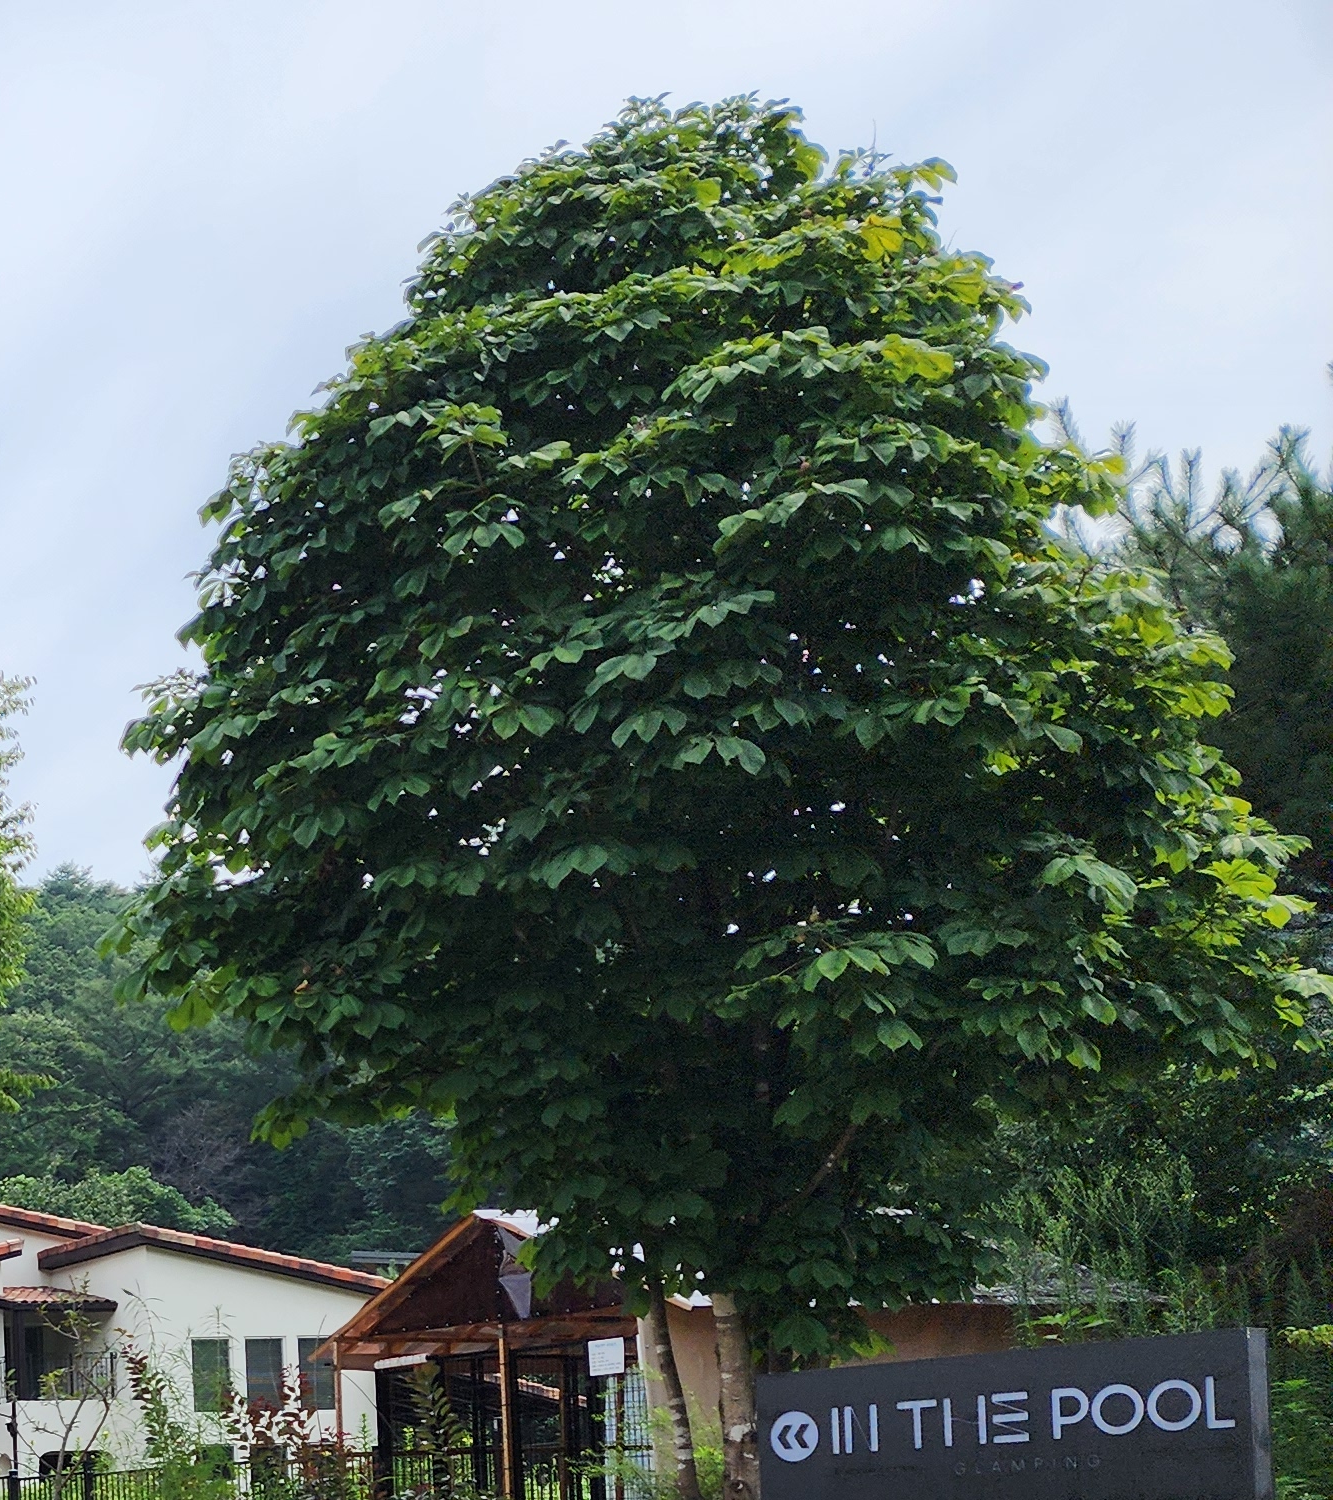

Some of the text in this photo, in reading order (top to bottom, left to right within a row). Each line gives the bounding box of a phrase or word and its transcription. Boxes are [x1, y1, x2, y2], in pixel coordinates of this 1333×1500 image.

[831, 1376, 1235, 1454] IN THE POOL
[953, 1454, 1101, 1477] GLAMPING
